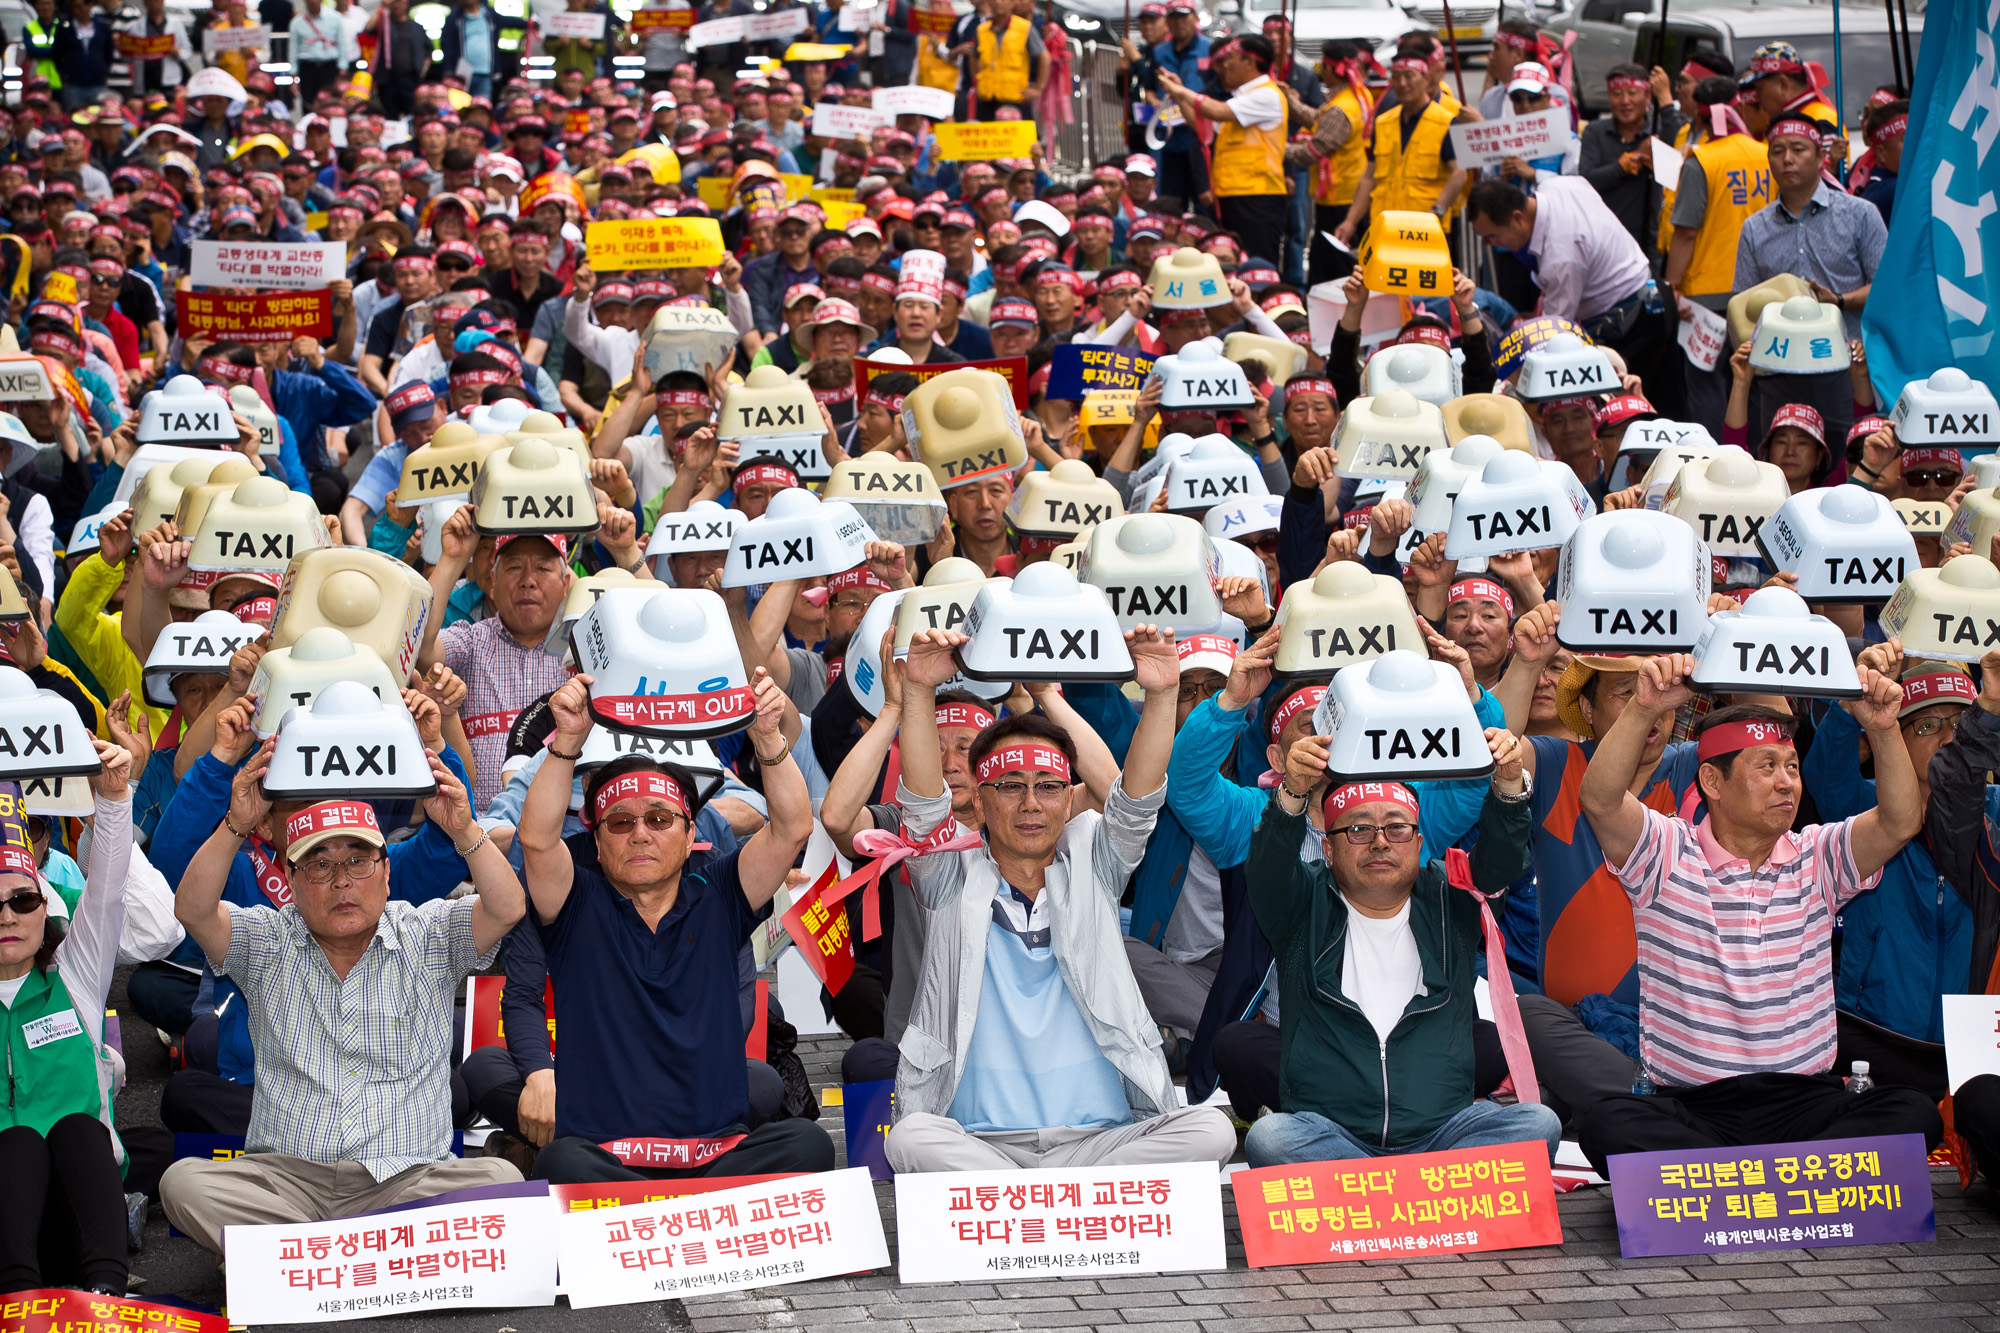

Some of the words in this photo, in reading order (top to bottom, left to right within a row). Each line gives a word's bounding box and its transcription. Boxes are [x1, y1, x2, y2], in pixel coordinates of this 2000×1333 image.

[1726, 167, 1771, 206] 질서
[1398, 229, 1429, 242] TAXI
[670, 311, 722, 326] TAXI
[1081, 367, 1140, 390] 투자사기
[1182, 378, 1238, 397] TAXI
[1545, 365, 1602, 388] TAXI
[158, 412, 220, 432] TAXI
[738, 404, 805, 428] TAXI
[1924, 412, 1989, 434] TAXI
[260, 427, 274, 444] 인
[411, 461, 479, 492] TAXI
[761, 466, 788, 482] 결단
[941, 447, 1008, 479] TAXI
[849, 471, 923, 493] TAXI
[1184, 475, 1249, 499] TAXI
[501, 495, 574, 519] TAXI
[1044, 499, 1112, 526] TAXI
[666, 521, 732, 541] TAXI
[1466, 505, 1552, 541] TAXI
[1698, 513, 1766, 545] TAX
[215, 531, 294, 559] TAXI
[739, 536, 814, 570] TAXI
[1713, 560, 1727, 577] GO
[1824, 556, 1905, 585] TAXI
[1105, 585, 1188, 616] TAXI
[1473, 582, 1501, 601] 결단
[920, 602, 966, 630] TA
[1588, 608, 1678, 636] TAXI
[1003, 628, 1099, 660] TAXI
[1199, 635, 1232, 652] 결단
[1304, 623, 1396, 658] TAXI
[1733, 642, 1830, 676] TAXI
[1937, 677, 1968, 694] 결단
[615, 700, 697, 721] 택시규제
[704, 694, 747, 716] OUT
[935, 708, 967, 724] 결단
[1271, 694, 1306, 735] 정치적
[466, 715, 501, 735] 정치적
[605, 729, 693, 756] TAXI
[1364, 727, 1460, 760] TAXI
[296, 744, 396, 777] TAXI
[978, 750, 1025, 778] 정치적
[1034, 749, 1066, 772] 결단
[596, 778, 640, 810] 정치적
[648, 776, 680, 801] 결단
[1331, 782, 1386, 810] 정치적
[320, 806, 359, 826] 결단
[3, 850, 35, 874] 결단
[612, 1141, 689, 1163] 택시규제
[1261, 1176, 1315, 1204] 불법
[1333, 1169, 1397, 1197] '타다'
[1420, 1158, 1526, 1193] 방관하는
[1659, 1158, 1765, 1190] 국민분열
[1774, 1151, 1881, 1183] 공유경제
[949, 1183, 1081, 1211] 교통생태계
[1092, 1179, 1171, 1205] 교란종
[1647, 1194, 1713, 1223] '타다'
[1726, 1192, 1779, 1219] 퇴출
[1788, 1184, 1902, 1216] 그날까지!
[605, 1203, 739, 1244] 교통생태계
[748, 1188, 826, 1222] 교란종
[1268, 1204, 1382, 1234] 대통령님,
[1390, 1190, 1531, 1226] 사과하세요!
[279, 1225, 415, 1260] 교통생태계
[426, 1214, 506, 1243] 교란종
[950, 1218, 1046, 1245] '타다'를
[1056, 1214, 1172, 1242] 박멸하라!
[1329, 1230, 1479, 1254] 서울개인택시운송사업조합
[1703, 1222, 1854, 1246] 서울개인택시운송사업조합
[612, 1241, 708, 1272] '타다'를
[716, 1221, 832, 1258] 박멸하라!
[281, 1262, 377, 1291] '타다'를
[388, 1249, 507, 1280] 박멸하라!
[986, 1251, 1141, 1271] 서울개인택시운송사업조합
[653, 1260, 805, 1292] 서울개인택시운송사업조합
[316, 1285, 474, 1313] 서울개인택시운송사업조합
[90, 1301, 201, 1333] 방관하는
